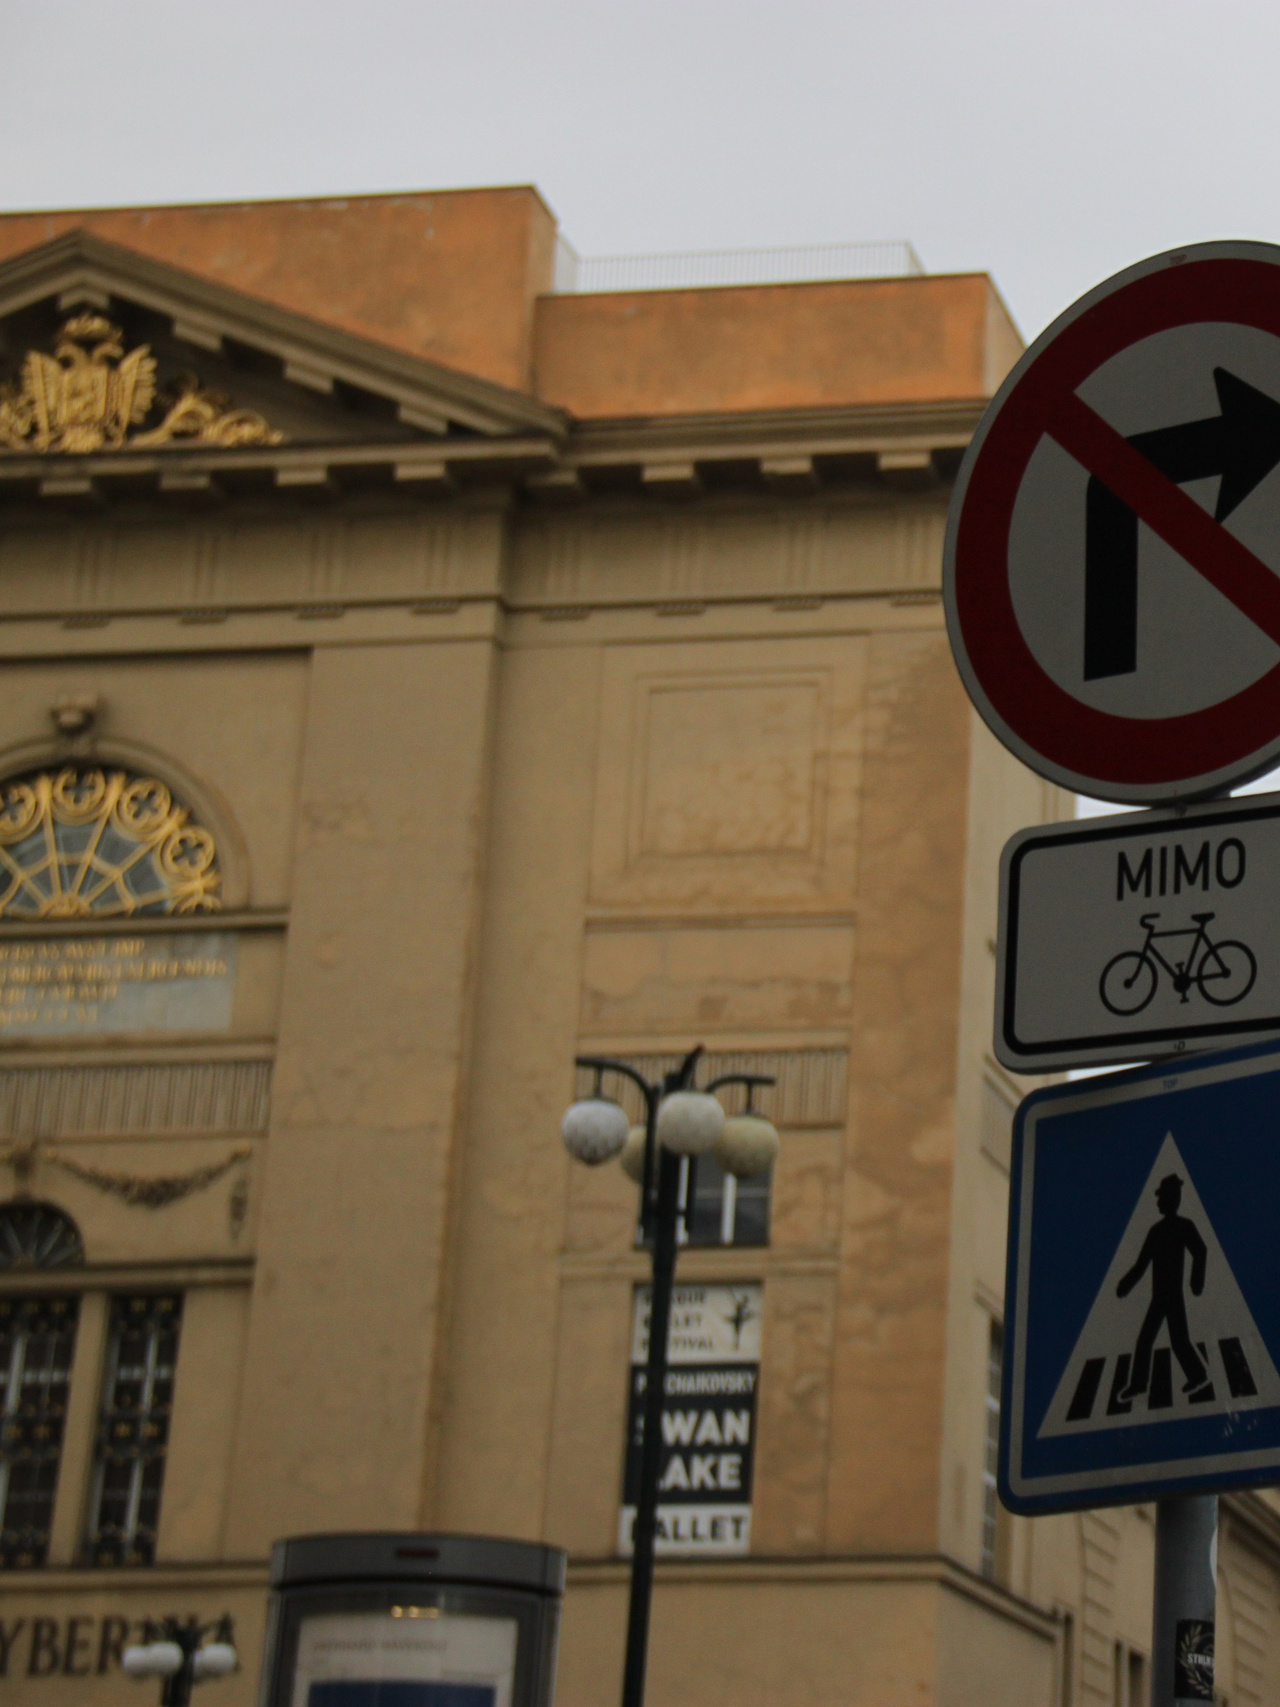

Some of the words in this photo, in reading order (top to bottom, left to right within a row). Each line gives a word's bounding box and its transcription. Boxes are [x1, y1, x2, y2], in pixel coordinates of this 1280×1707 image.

[1116, 838, 1246, 901] MIMO
[664, 1371, 755, 1395] CHAIKOVSKY
[658, 1454, 743, 1490] AKE
[632, 1515, 745, 1541] ALLET
